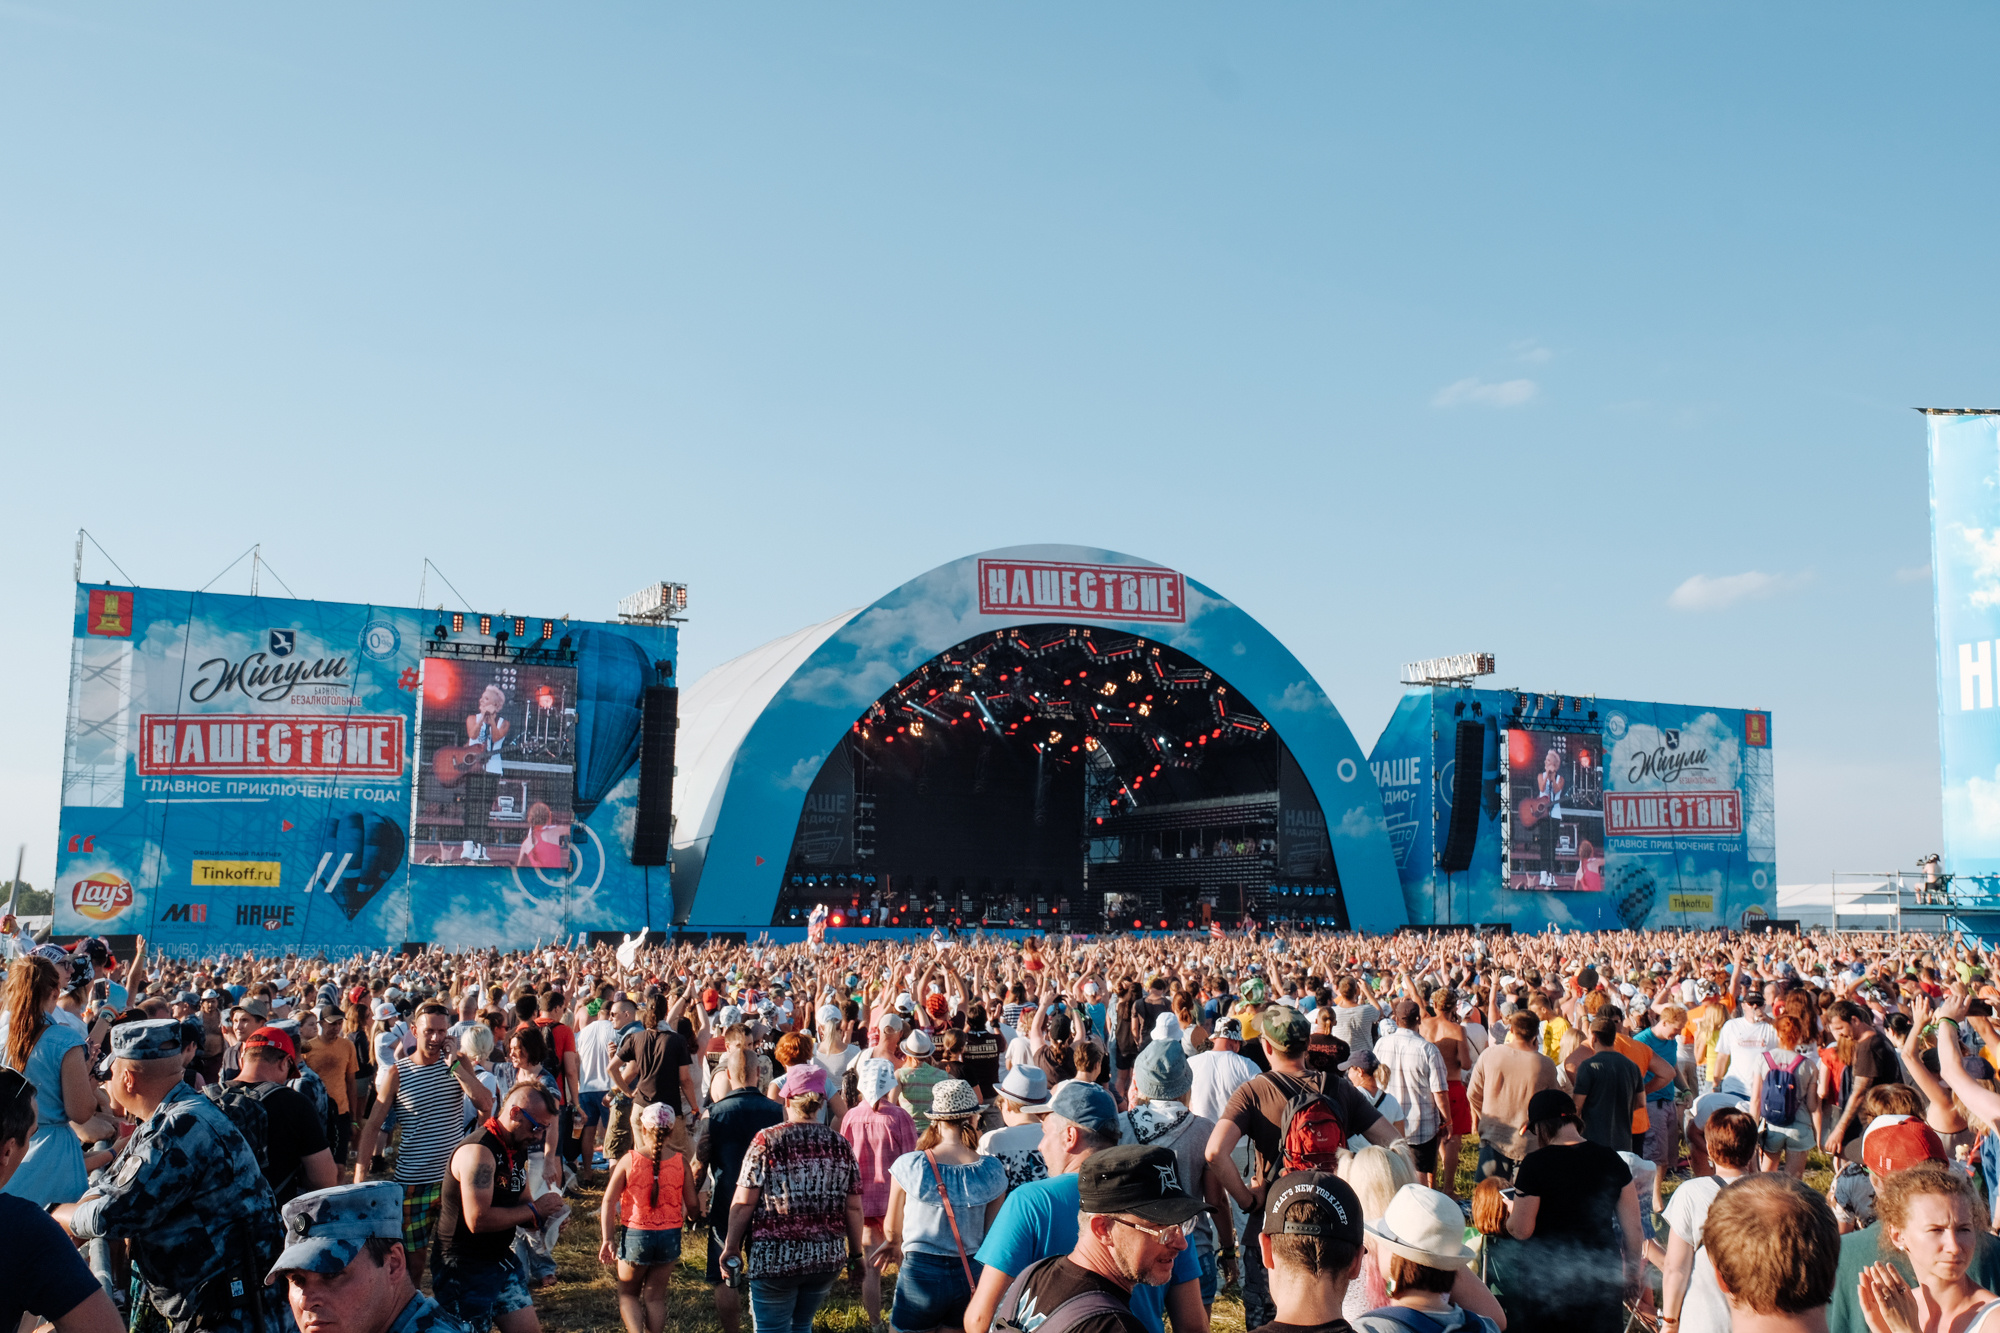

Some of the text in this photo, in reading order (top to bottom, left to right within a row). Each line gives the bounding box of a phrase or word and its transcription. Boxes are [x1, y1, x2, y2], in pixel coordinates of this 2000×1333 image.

[988, 569, 1175, 613] НАШЕСТВИЕ
[190, 652, 350, 703] Жигули
[291, 695, 363, 706] БЕЗАЛКОГОЛЬНОЕ
[152, 722, 389, 766] НАШЕСТВИЕ
[1628, 746, 1709, 784] Жигули
[141, 779, 400, 803] ГЛАВНОЕ ПРИКЛЮЧЕНИЕ ГОДА!
[806, 794, 847, 813] АШЕ
[1611, 797, 1733, 828] НАШЕСТВИЕ
[1285, 809, 1326, 828] НАШ
[1608, 839, 1742, 852] ГЛАВНОЕ ПРИКЛЮЧЕНИЕ ГОДА!
[201, 866, 273, 881] Tinkoff.ru
[75, 881, 130, 913] Lay's
[1673, 898, 1710, 909] Tinkoff.ru
[236, 904, 295, 926] НАШЕ
[167, 943, 198, 956] ПИВО
[1272, 1184, 1349, 1226] WHAT'S NEW YORK LIKE?
